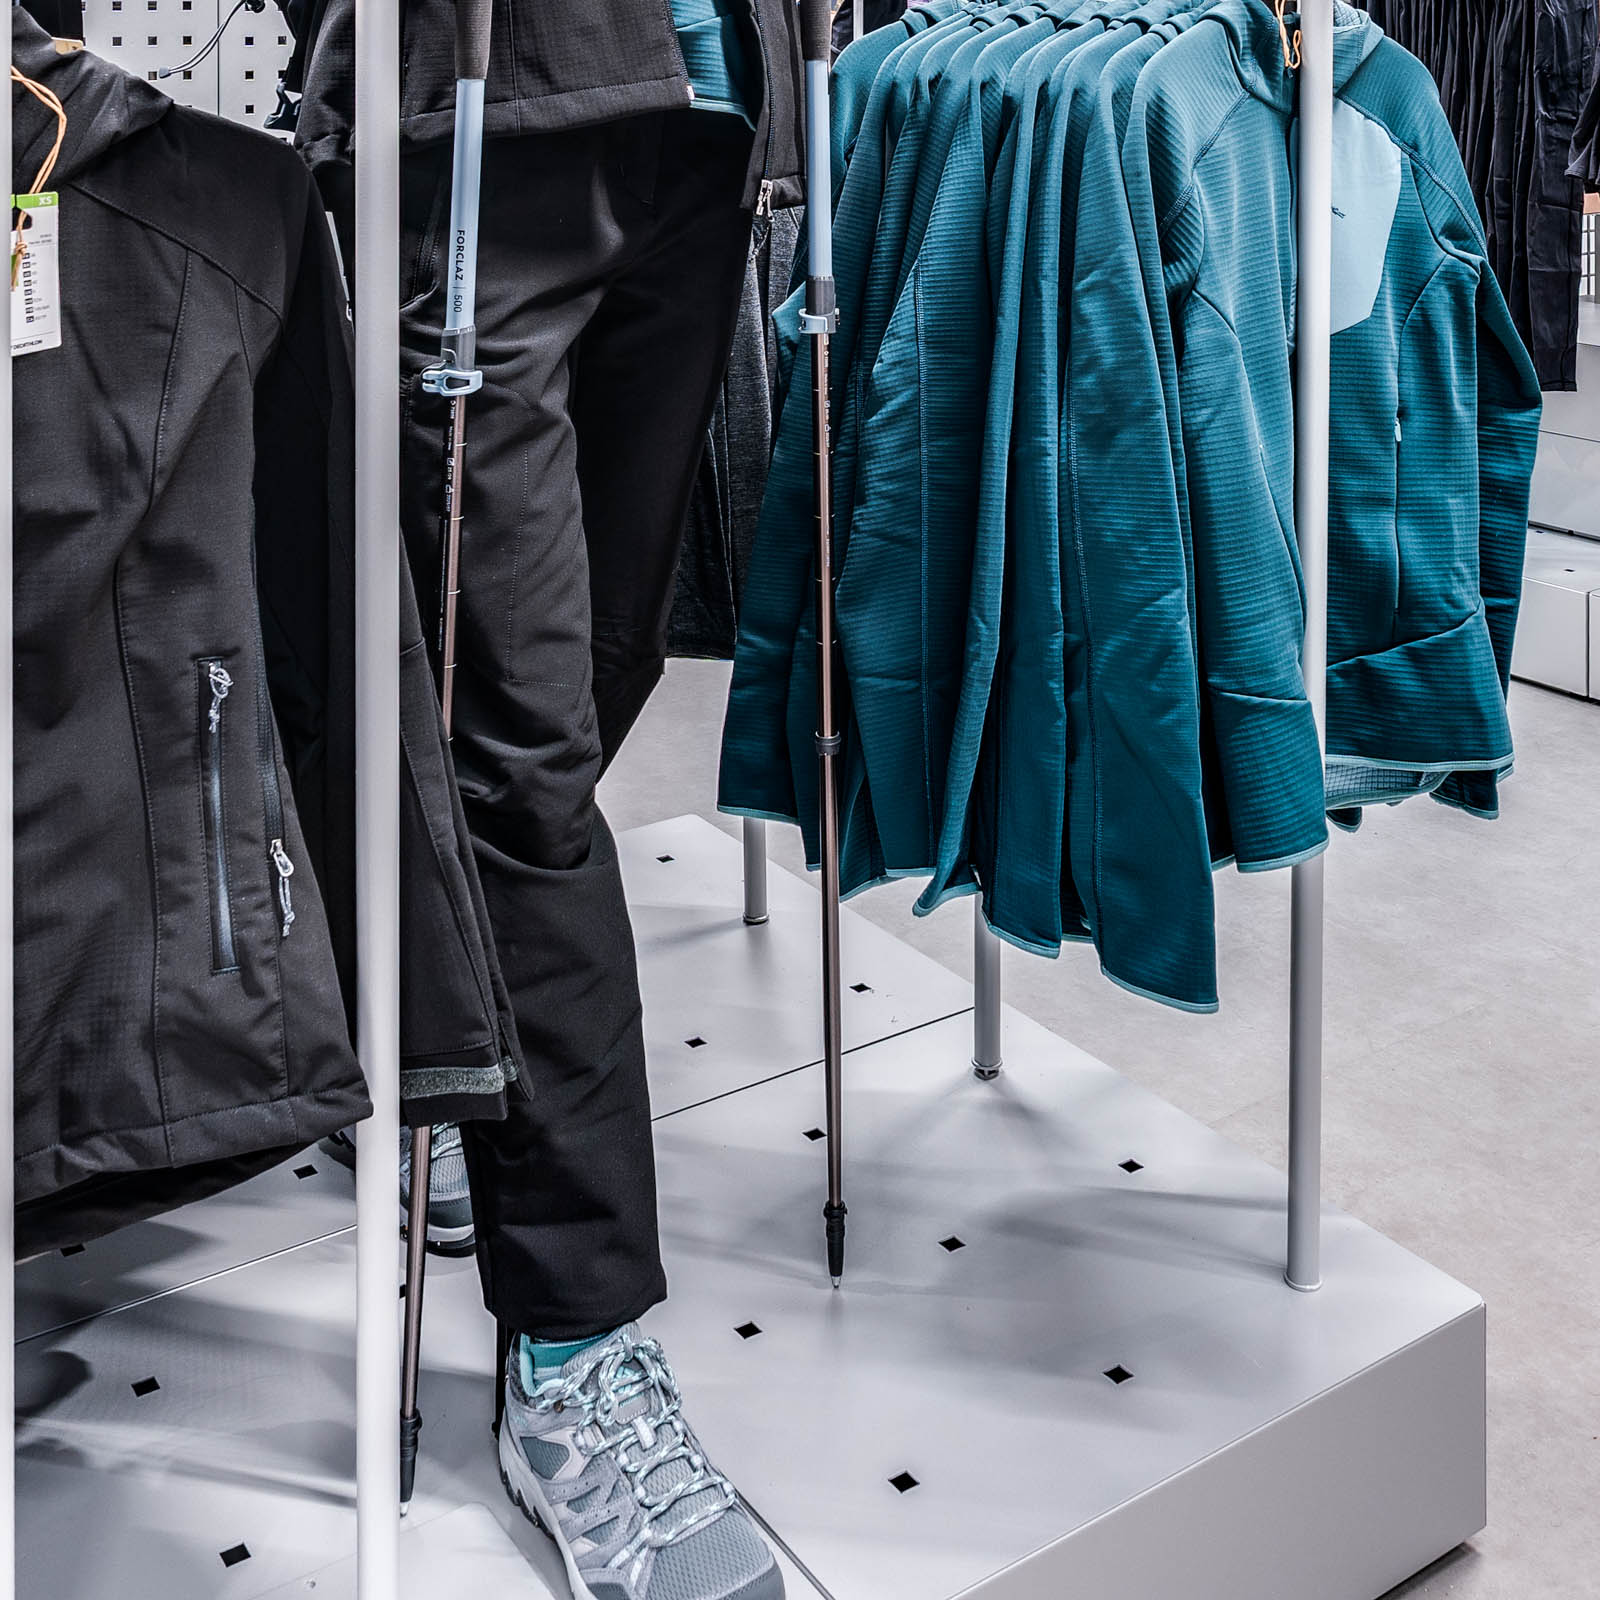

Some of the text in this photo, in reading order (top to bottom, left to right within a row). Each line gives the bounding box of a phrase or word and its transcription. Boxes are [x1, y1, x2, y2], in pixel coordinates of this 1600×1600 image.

[38, 196, 52, 205] XS
[453, 229, 465, 313] FORCLAZ 500
[13, 339, 43, 350] DECATHLON
